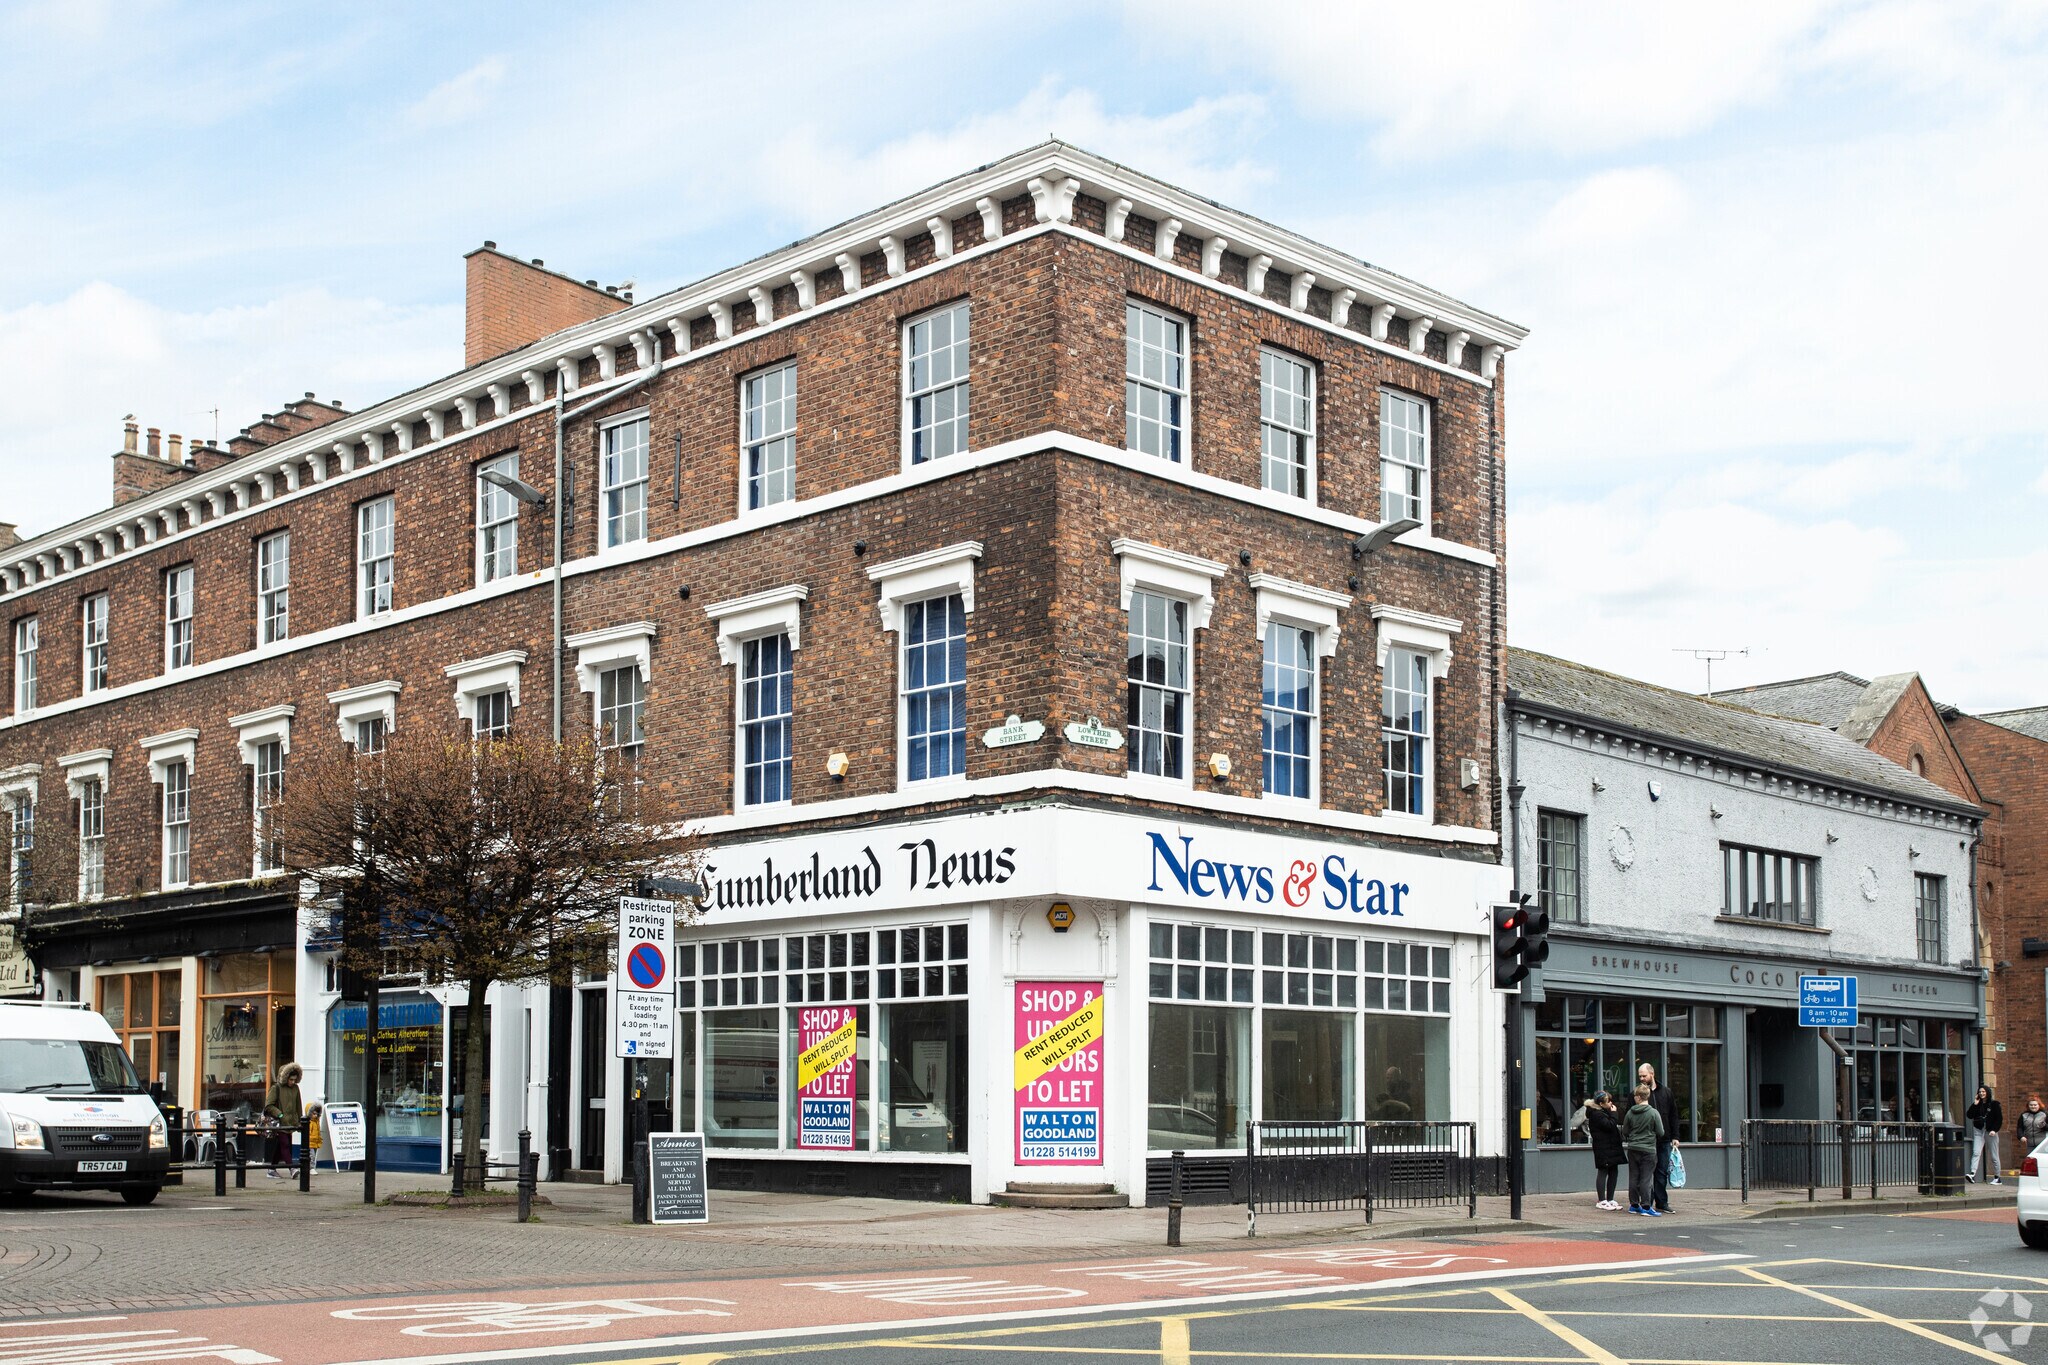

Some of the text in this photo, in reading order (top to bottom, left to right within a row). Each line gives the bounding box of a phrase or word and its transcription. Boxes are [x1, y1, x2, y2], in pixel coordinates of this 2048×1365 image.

[1002, 725, 1024, 735] BANK
[1077, 725, 1112, 738] LOWTHER
[999, 733, 1028, 744] STREET
[1080, 735, 1109, 745] STREET
[693, 838, 1017, 913] Cumberland News
[1145, 831, 1409, 917] News & Star
[622, 899, 672, 914] Restricted
[629, 914, 665, 927] parking
[1055, 912, 1067, 920] ADT
[628, 926, 665, 940] ZONE
[1592, 955, 1679, 974] BREWHOUSE
[0, 965, 17, 981] Ltd
[1892, 983, 1938, 996] KITCHEN
[1021, 989, 1077, 1012] SHOP
[629, 1003, 651, 1012] Except
[332, 1002, 440, 1030] SEWIN SOLUTIONS
[634, 1012, 657, 1020] loading
[803, 1009, 839, 1031] SHOP
[351, 1032, 367, 1042] Types
[377, 1029, 429, 1039] Clothes Alterations
[1023, 1040, 1049, 1061] RENT
[1049, 1010, 1094, 1044] REDUCED
[353, 1046, 365, 1054] Also
[395, 1044, 416, 1053] Leather
[802, 1049, 820, 1066] RENT
[820, 1028, 853, 1054] REDUCED
[1041, 1046, 1067, 1067] WILL
[1066, 1028, 1093, 1052] SPLIT
[813, 1058, 831, 1074] WILL
[831, 1045, 849, 1065] SPLIT
[826, 1074, 849, 1095] LET
[1027, 1080, 1094, 1103] TO LET
[804, 1103, 850, 1114] WALTON
[803, 1116, 850, 1127] GOODLAND
[1025, 1114, 1094, 1125] WALTON
[802, 1133, 851, 1145] 01228 514199
[1024, 1128, 1095, 1139] GOODLAND
[656, 1138, 698, 1148] Annies
[1023, 1146, 1096, 1158] 01228 514199
[82, 1162, 123, 1171] TR57 CAD
[1253, 1247, 1509, 1269] BUS
[1051, 1259, 1345, 1289] TAXI
[780, 1275, 1090, 1306] AND
